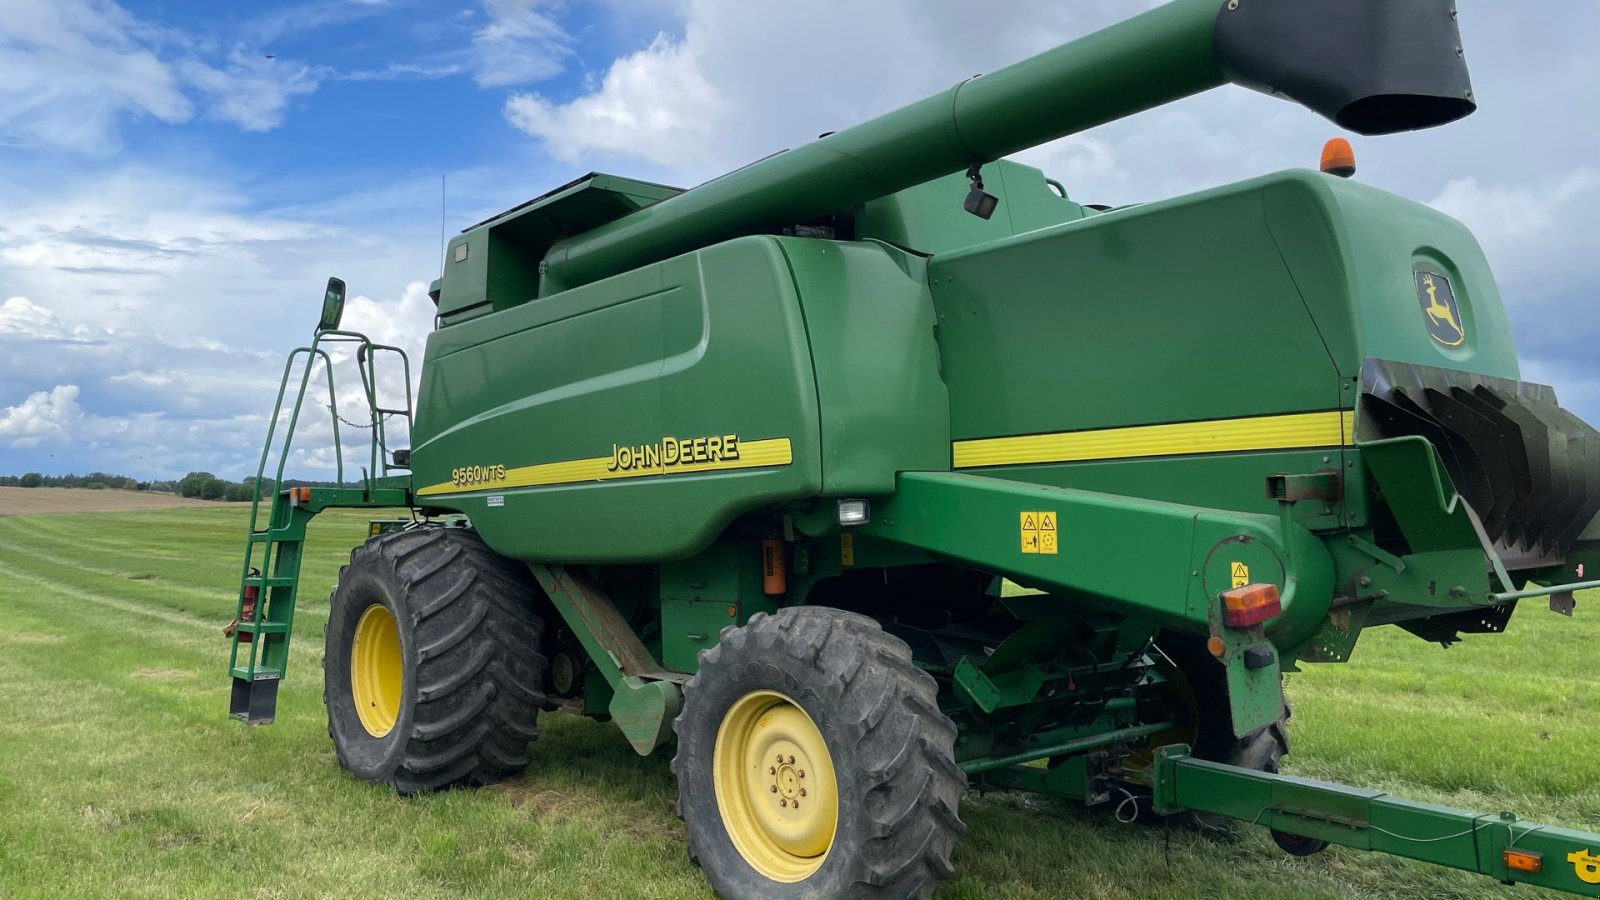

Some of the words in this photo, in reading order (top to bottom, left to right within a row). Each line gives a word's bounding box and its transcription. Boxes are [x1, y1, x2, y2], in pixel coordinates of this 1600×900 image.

[607, 443, 662, 472] JOHN
[662, 433, 739, 466] DEERE
[452, 464, 505, 486] 9560WTS
